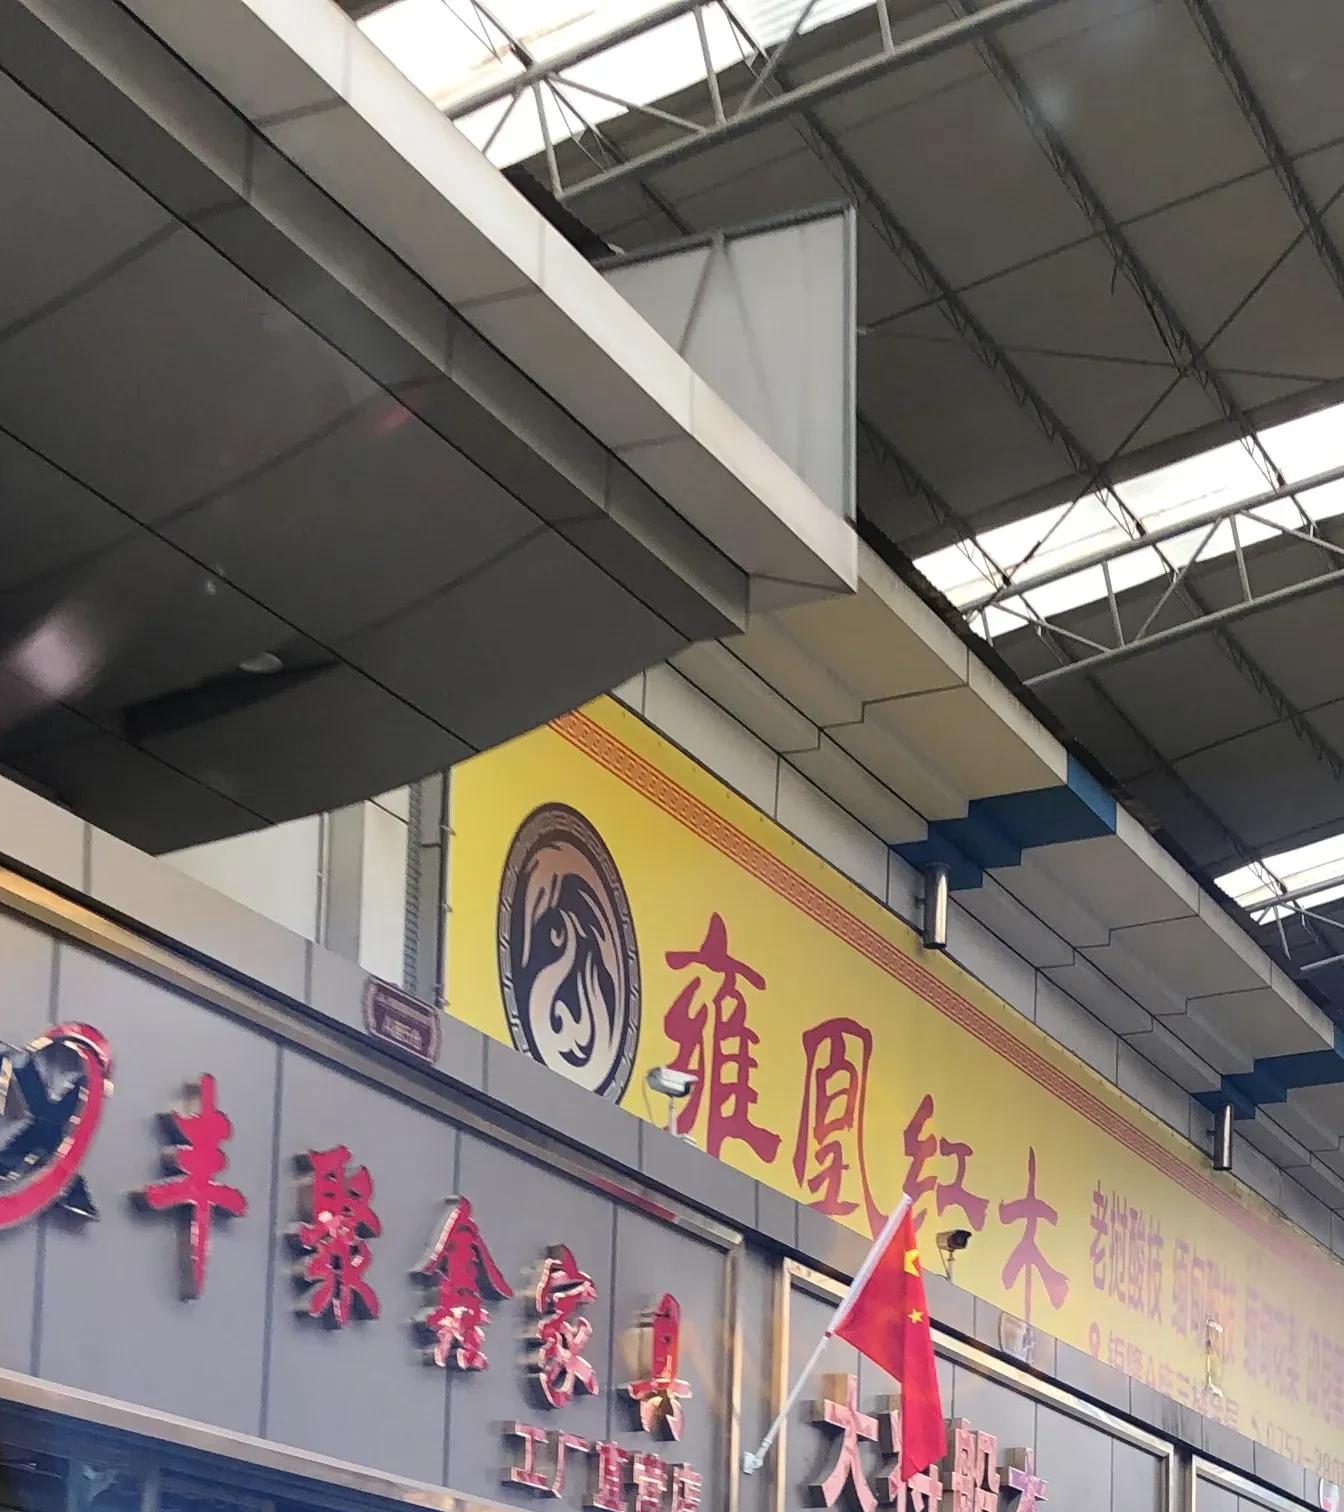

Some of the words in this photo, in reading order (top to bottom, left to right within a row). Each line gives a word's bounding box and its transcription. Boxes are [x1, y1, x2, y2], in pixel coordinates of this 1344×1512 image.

[146, 1073, 698, 1443] 丰聚鑫家具
[665, 912, 1069, 1312] 雍凰红木
